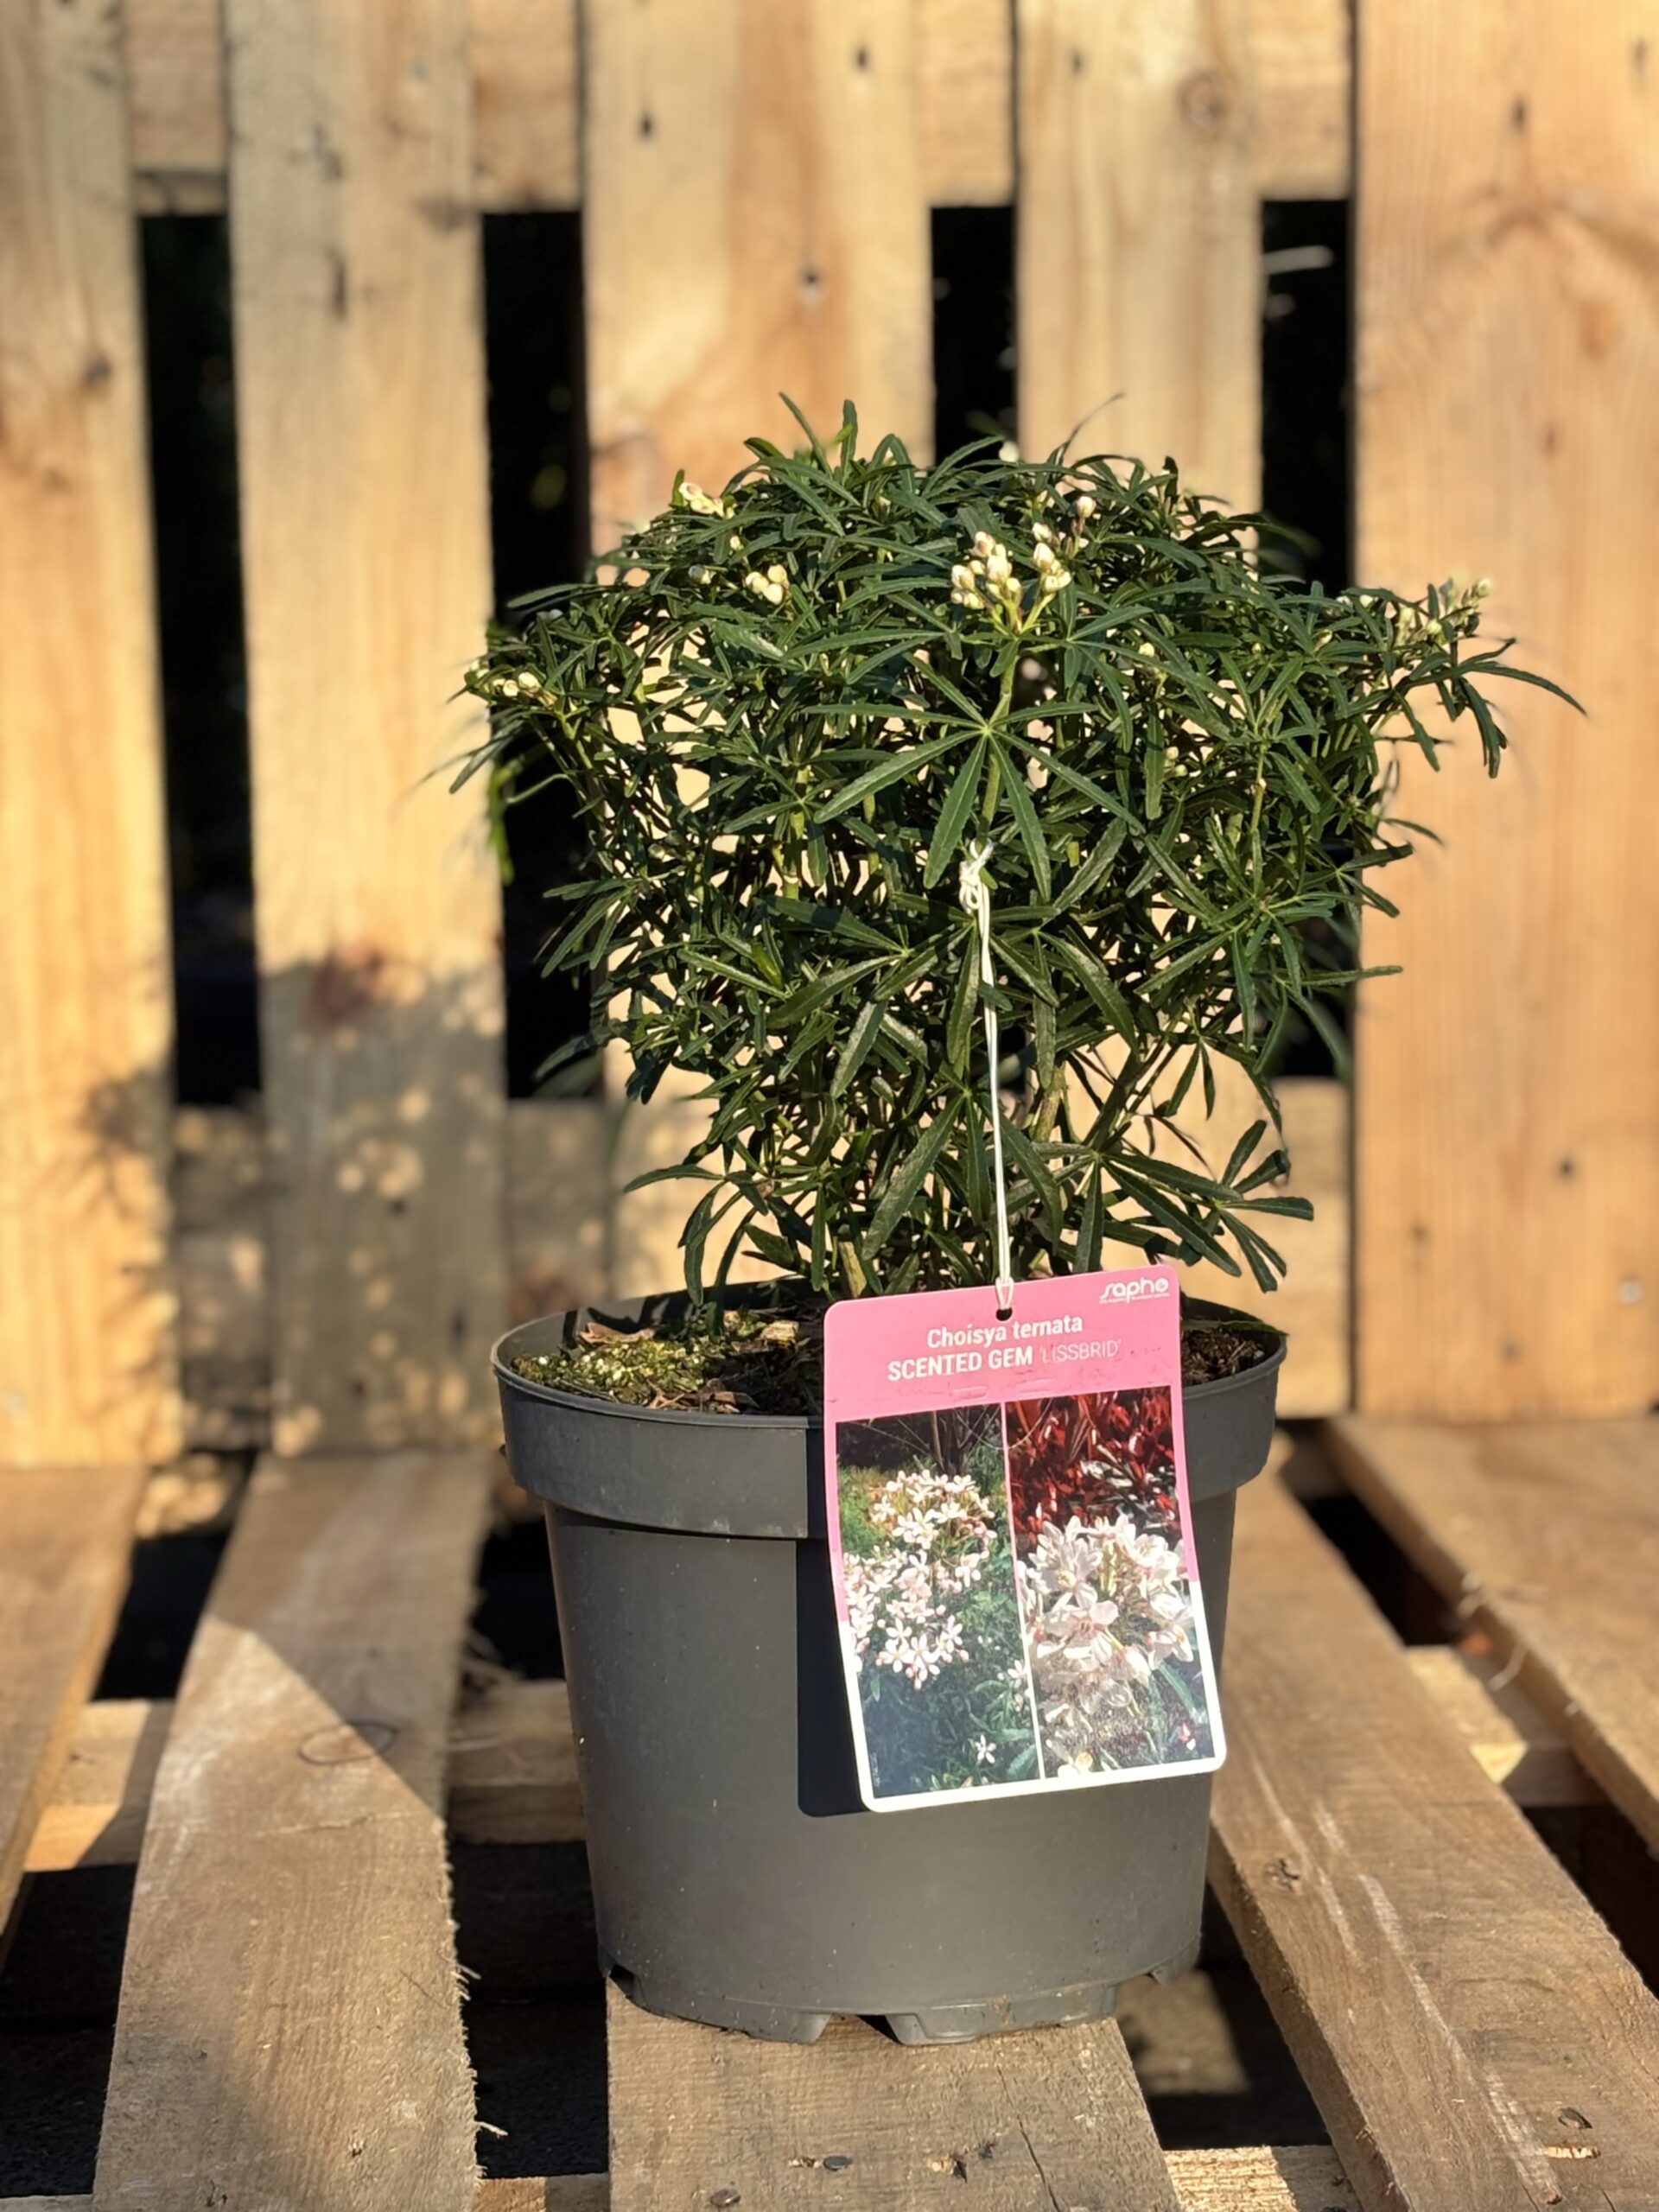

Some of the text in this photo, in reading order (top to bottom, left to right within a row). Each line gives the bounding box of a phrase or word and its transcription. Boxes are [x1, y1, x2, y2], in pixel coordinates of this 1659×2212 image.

[1099, 1277, 1169, 1303] sapho
[927, 1314, 1083, 1348] Choisya ternata
[887, 1352, 982, 1381] SCENTED
[988, 1345, 1033, 1370] GEM
